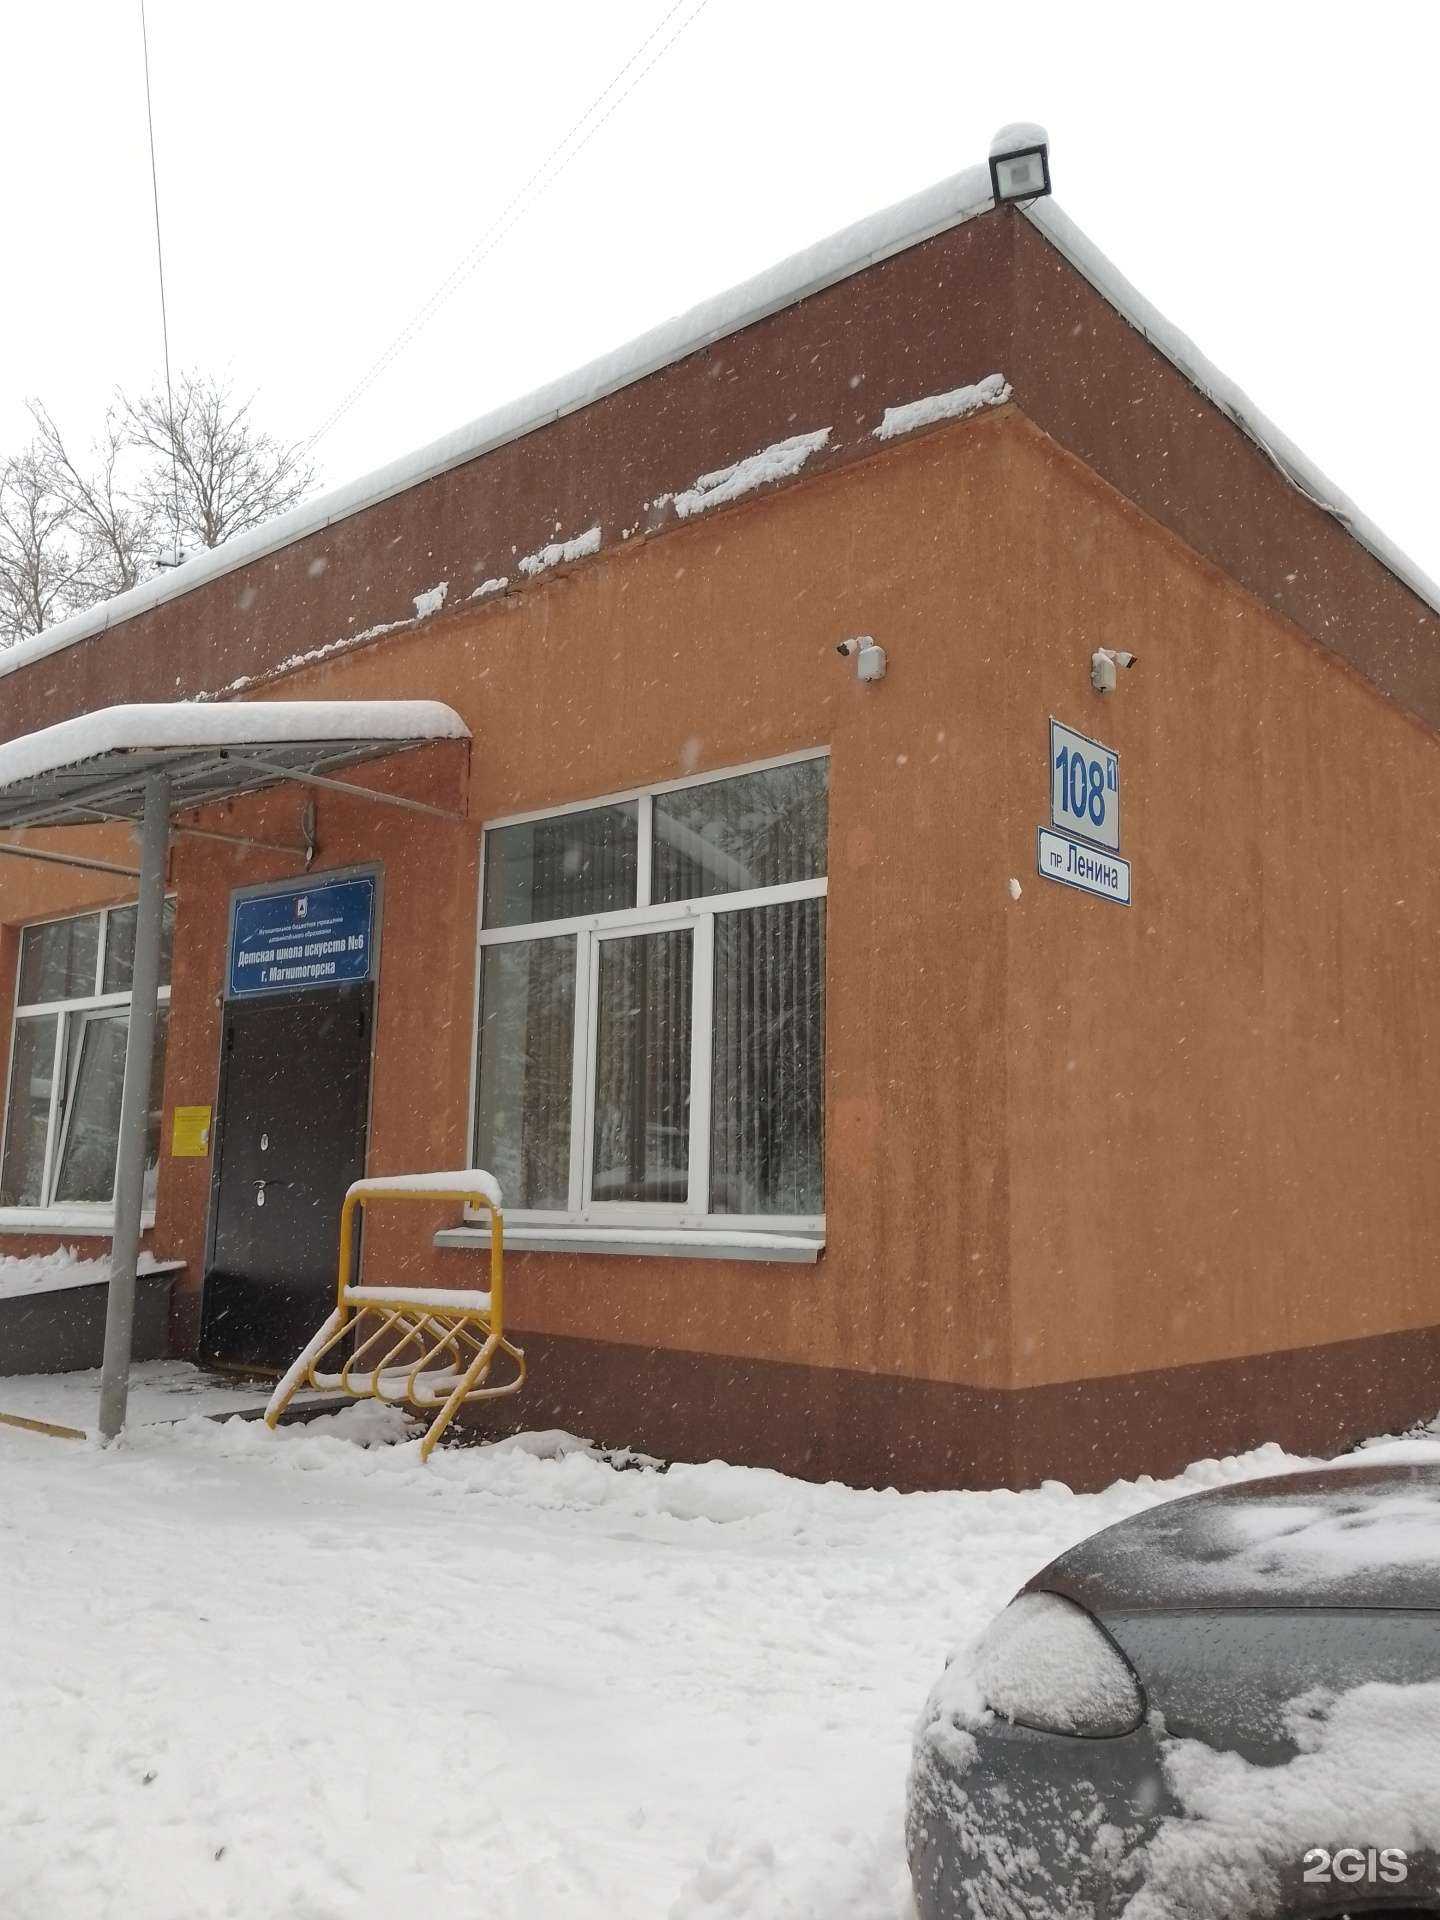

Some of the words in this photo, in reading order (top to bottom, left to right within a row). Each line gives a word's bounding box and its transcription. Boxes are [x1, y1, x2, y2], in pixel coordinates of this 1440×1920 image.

[1056, 746, 1105, 826] 108
[1067, 844, 1118, 890] Ленина
[238, 949, 274, 967] Детская
[277, 945, 303, 961] школа
[305, 939, 346, 957] искусств
[269, 962, 336, 982] Магнитогорска
